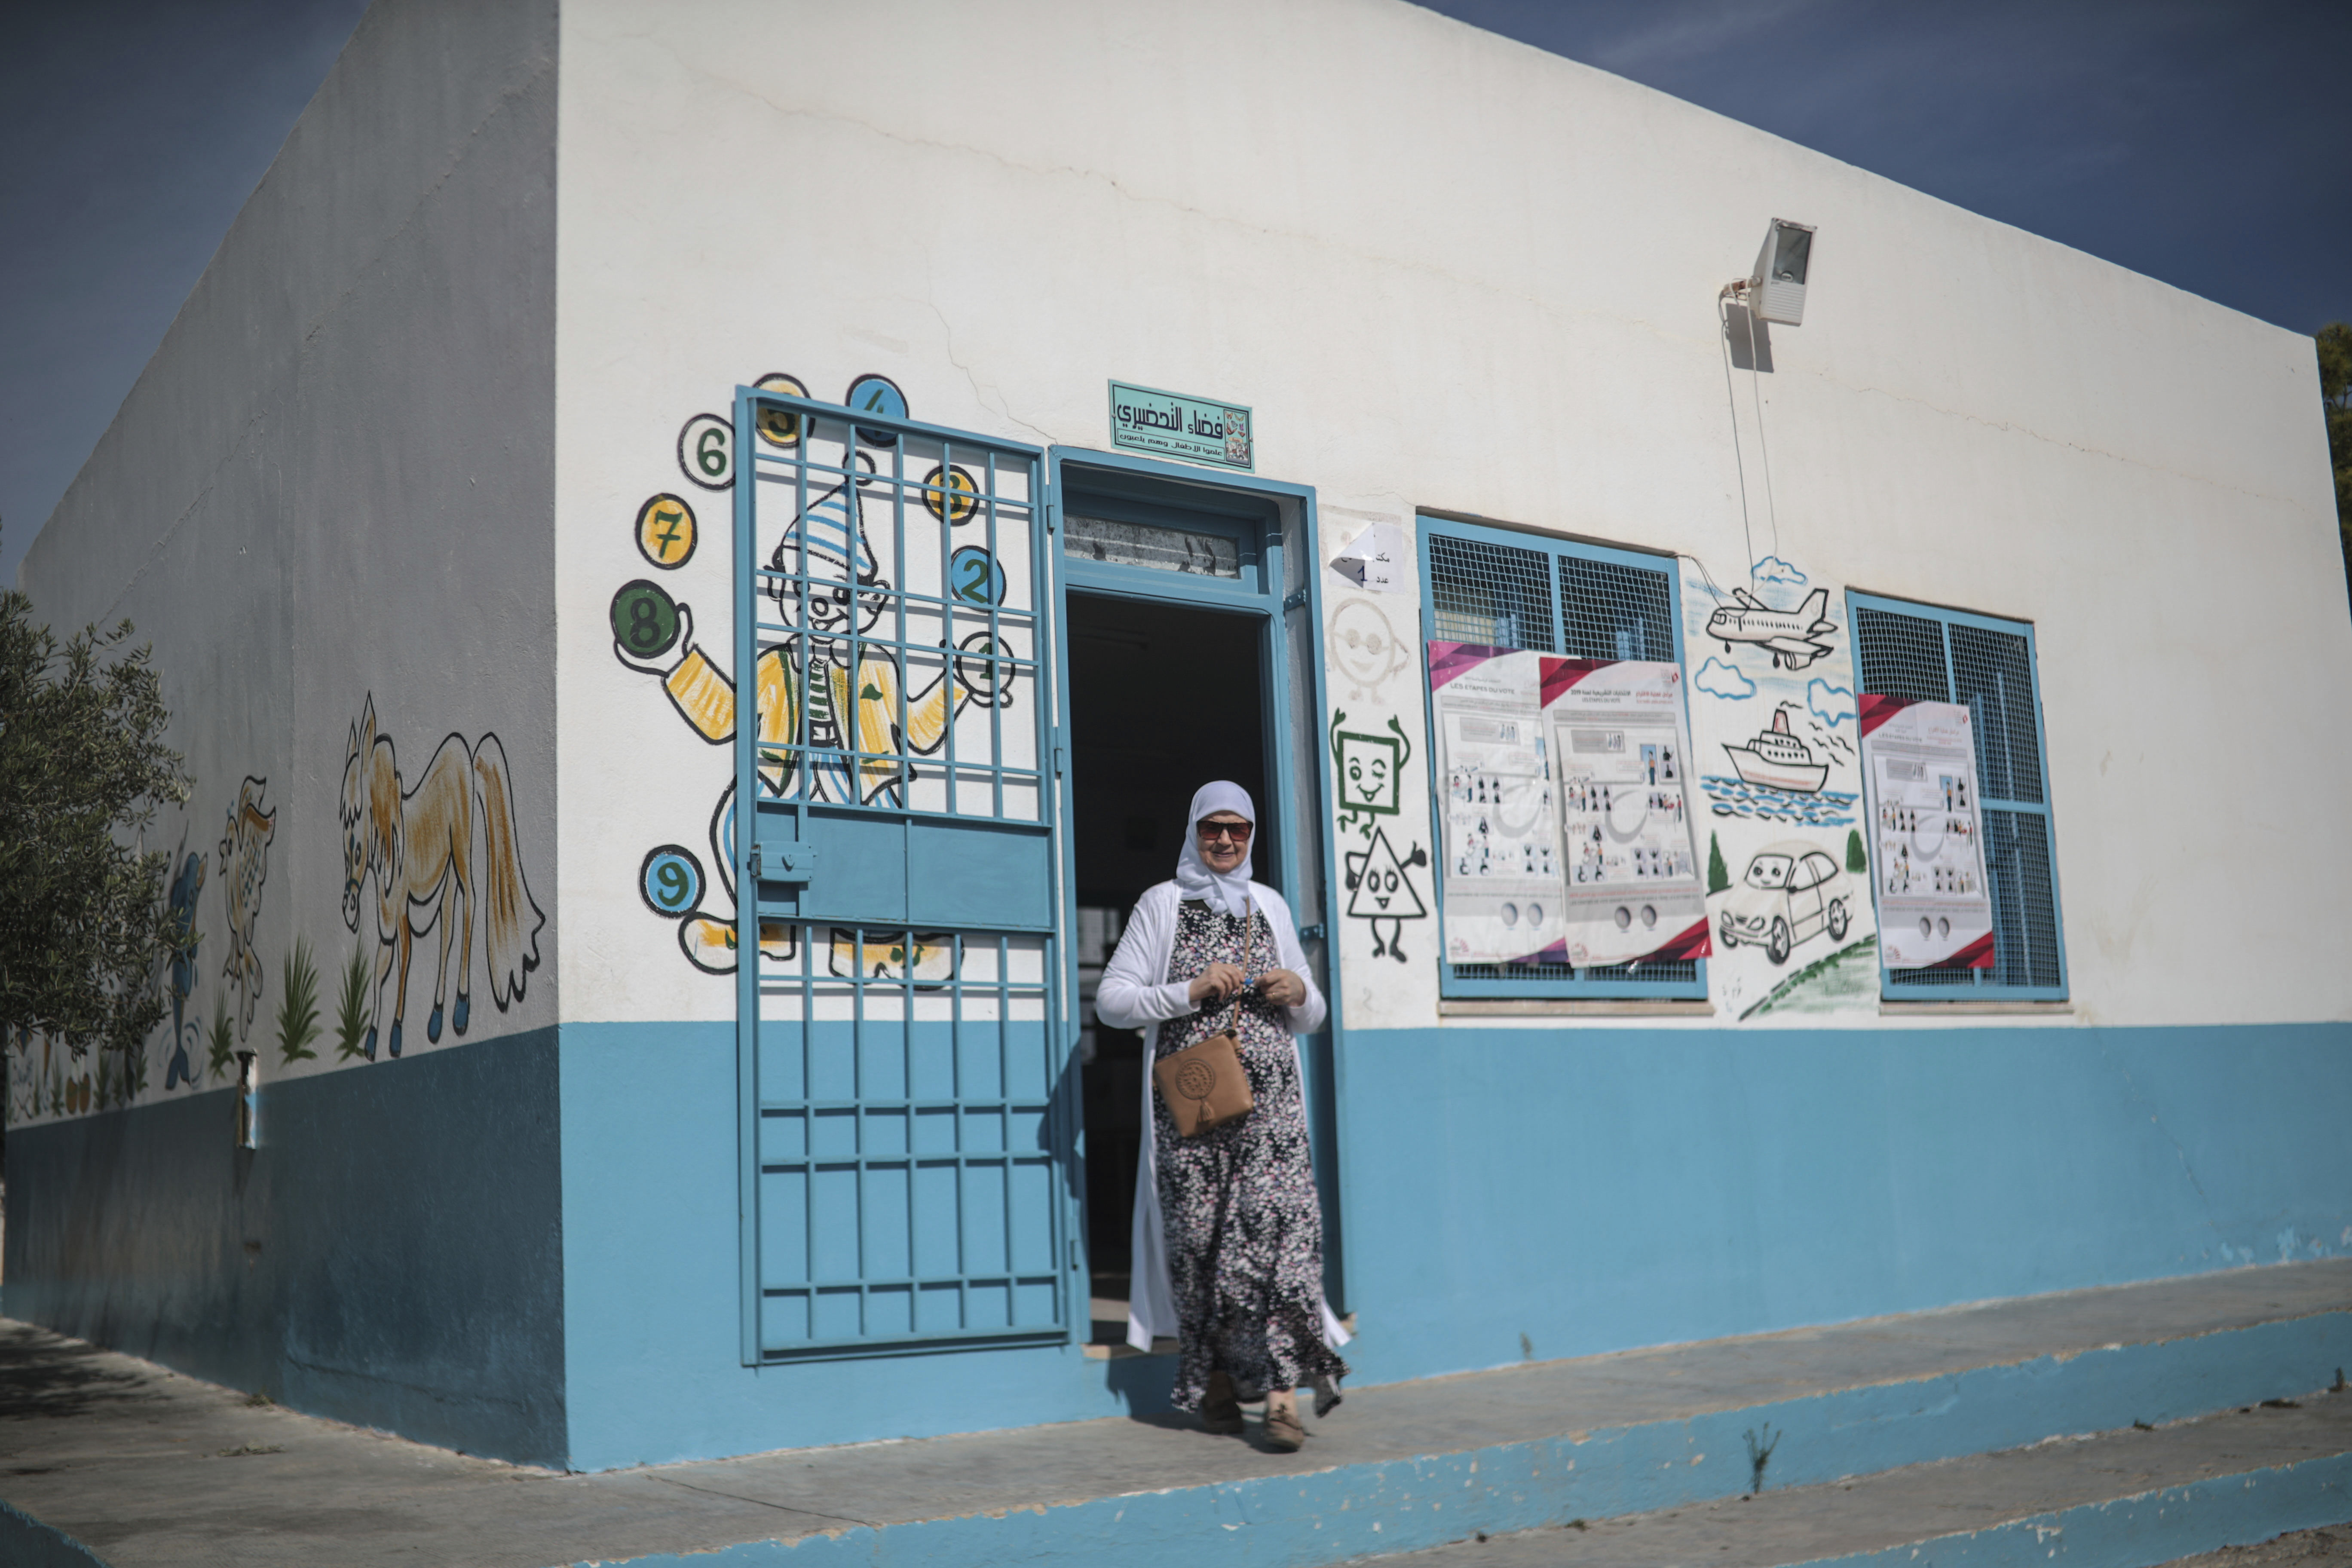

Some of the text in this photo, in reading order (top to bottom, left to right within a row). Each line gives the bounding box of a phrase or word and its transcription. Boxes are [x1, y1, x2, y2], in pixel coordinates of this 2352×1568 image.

[1118, 402, 1223, 439] فضاء التحضيري
[1120, 434, 1145, 443] يلعبون
[697, 428, 727, 477] 6
[1148, 438, 1168, 447] وهم
[1203, 447, 1222, 456] علموا
[938, 475, 962, 514] 3
[654, 511, 683, 559] 7
[961, 559, 989, 603] 2
[1357, 565, 1368, 581] 1
[631, 597, 661, 648] 8
[979, 643, 994, 680] 1
[657, 861, 689, 906] 9
